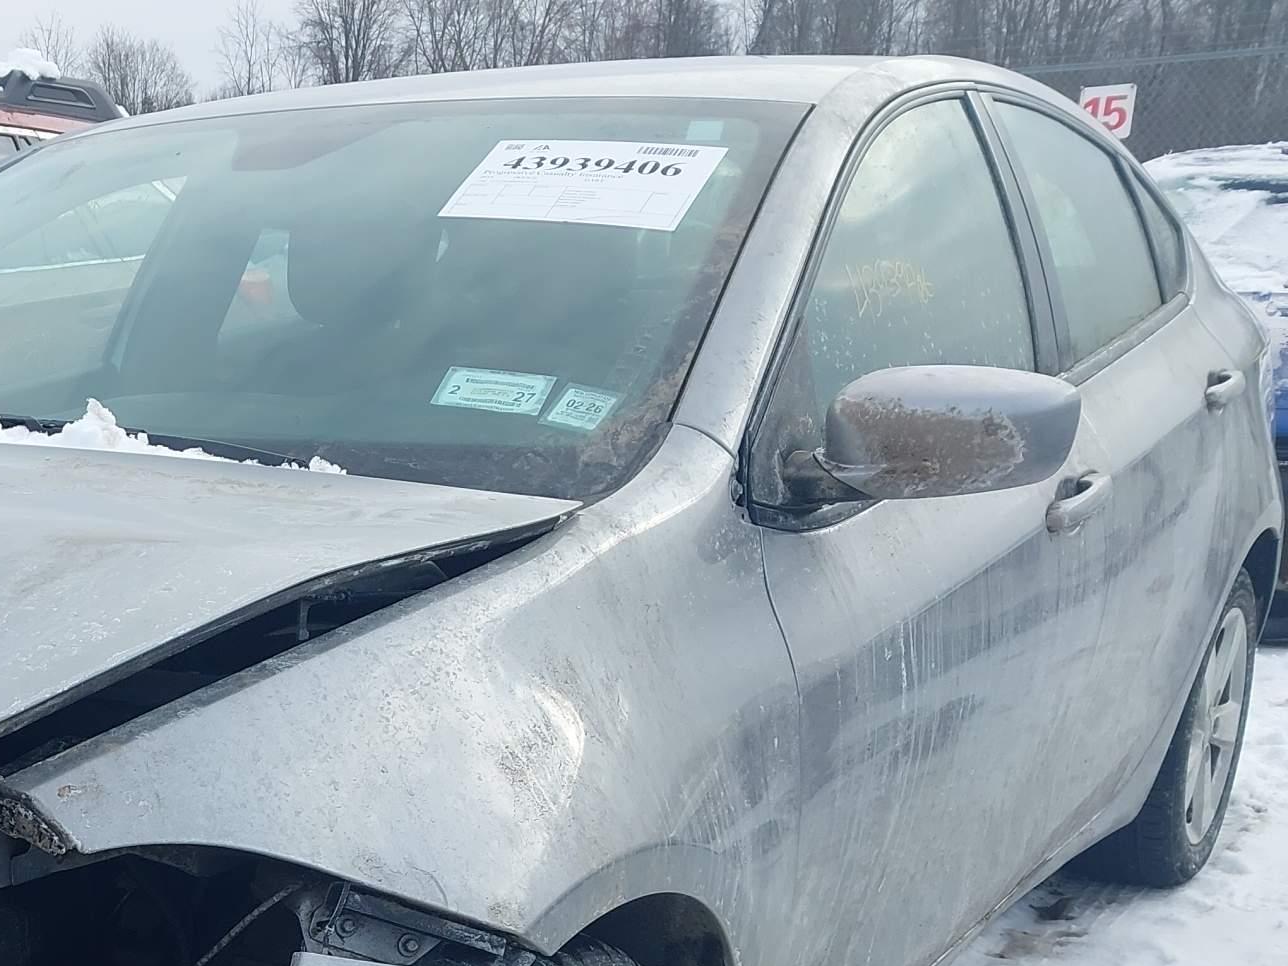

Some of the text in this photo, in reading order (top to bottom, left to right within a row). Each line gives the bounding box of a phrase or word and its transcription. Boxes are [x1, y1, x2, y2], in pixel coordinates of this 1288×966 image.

[1083, 94, 1129, 131] 15
[503, 155, 688, 177] 43939406
[448, 384, 461, 395] 2
[512, 391, 536, 402] 27
